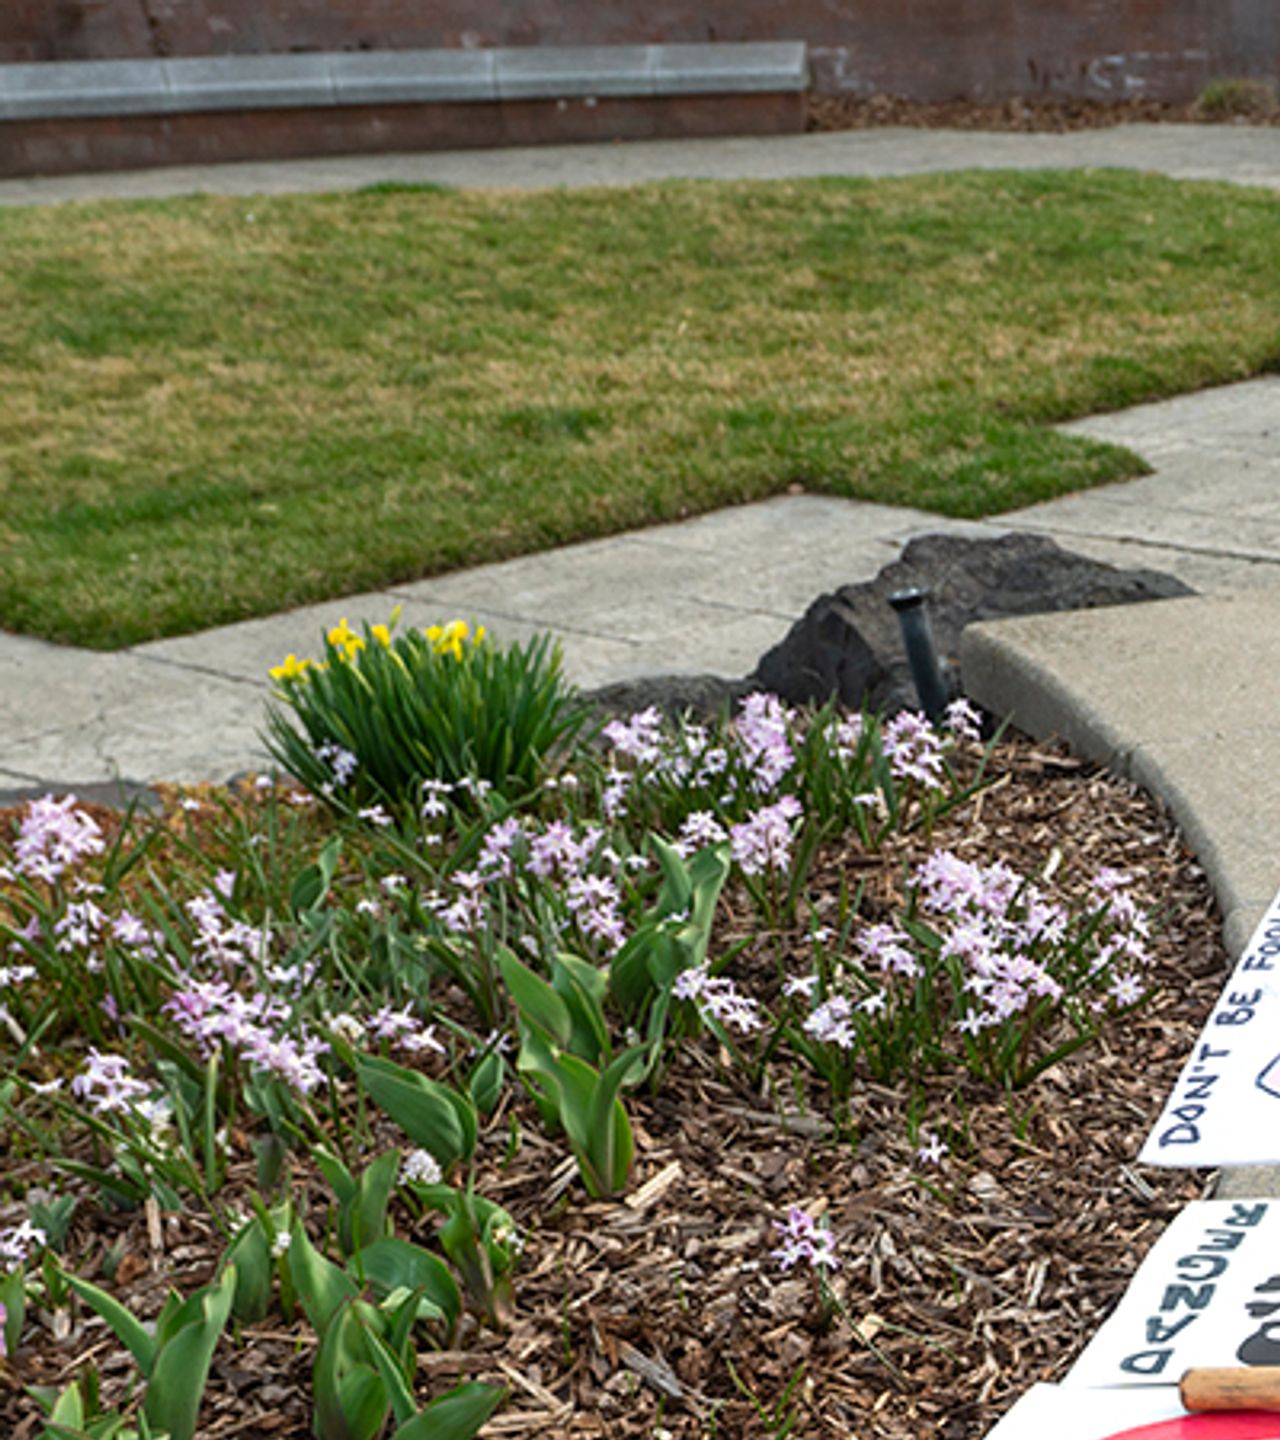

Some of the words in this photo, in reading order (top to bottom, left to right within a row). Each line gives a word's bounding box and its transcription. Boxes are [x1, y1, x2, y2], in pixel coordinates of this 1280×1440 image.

[1158, 1043, 1231, 1148] DON'T
[1214, 988, 1262, 1026] BE
[1119, 1203, 1268, 1374] DANGER
